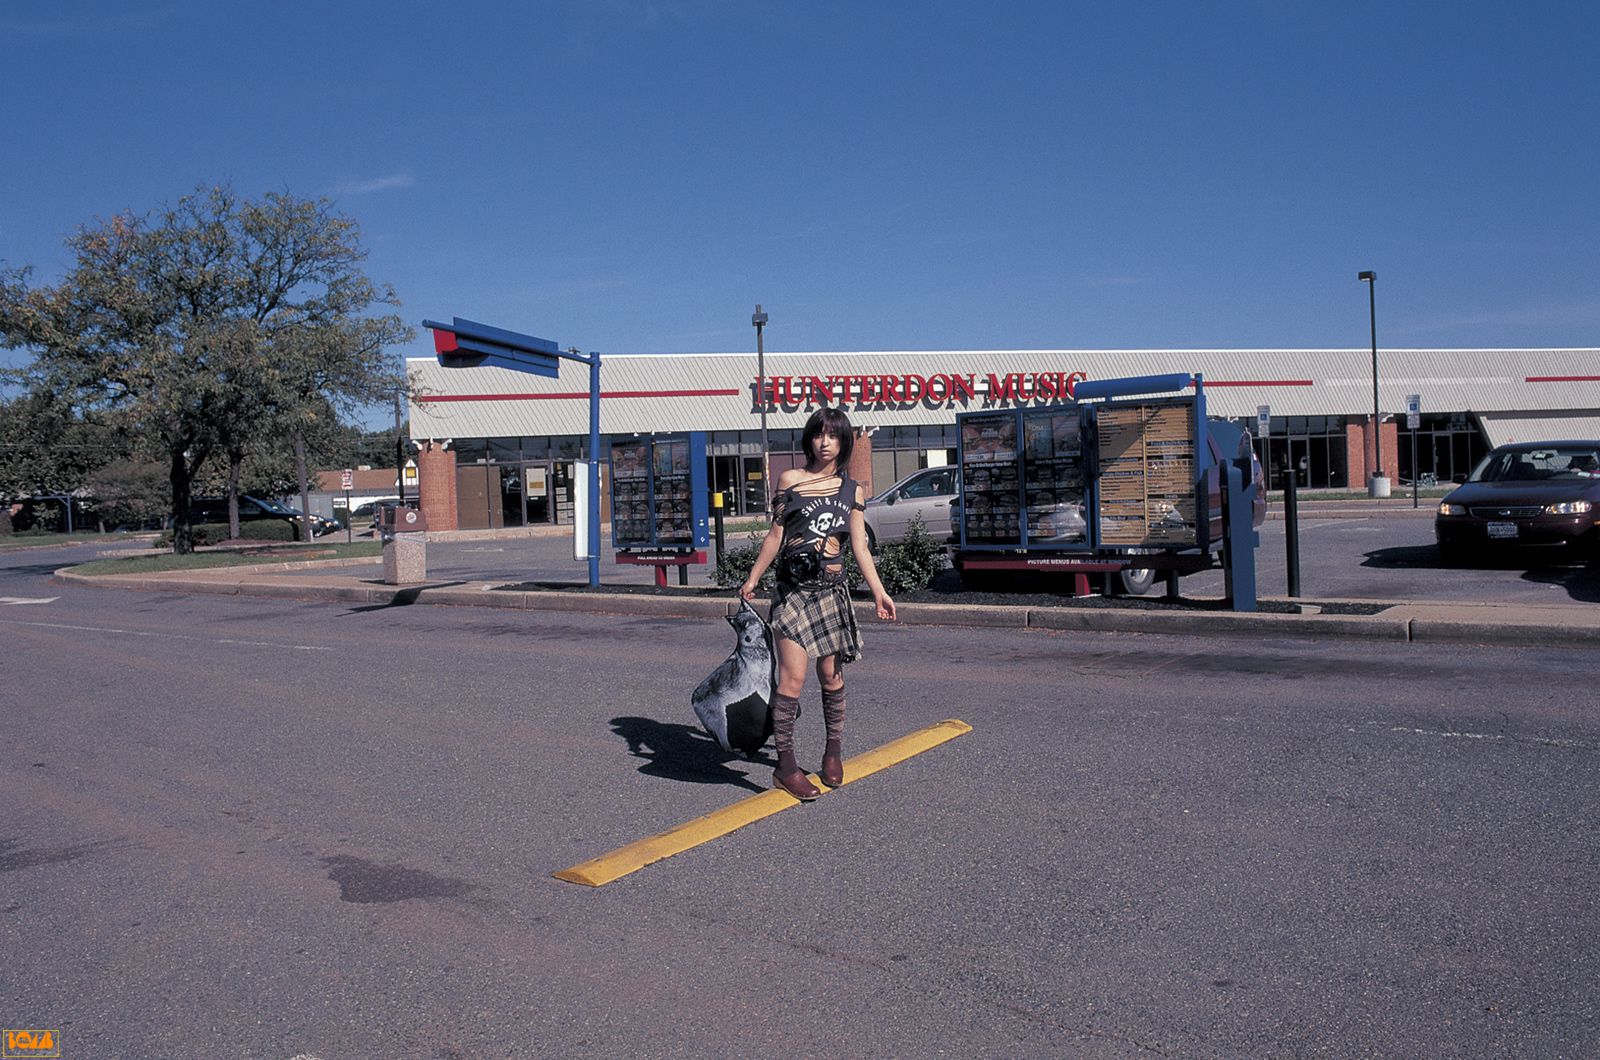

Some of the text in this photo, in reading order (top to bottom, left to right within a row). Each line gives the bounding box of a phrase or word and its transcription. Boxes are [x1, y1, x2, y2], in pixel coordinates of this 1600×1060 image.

[753, 371, 1087, 405] HUNTERDON MUSIC
[825, 497, 831, 505] &
